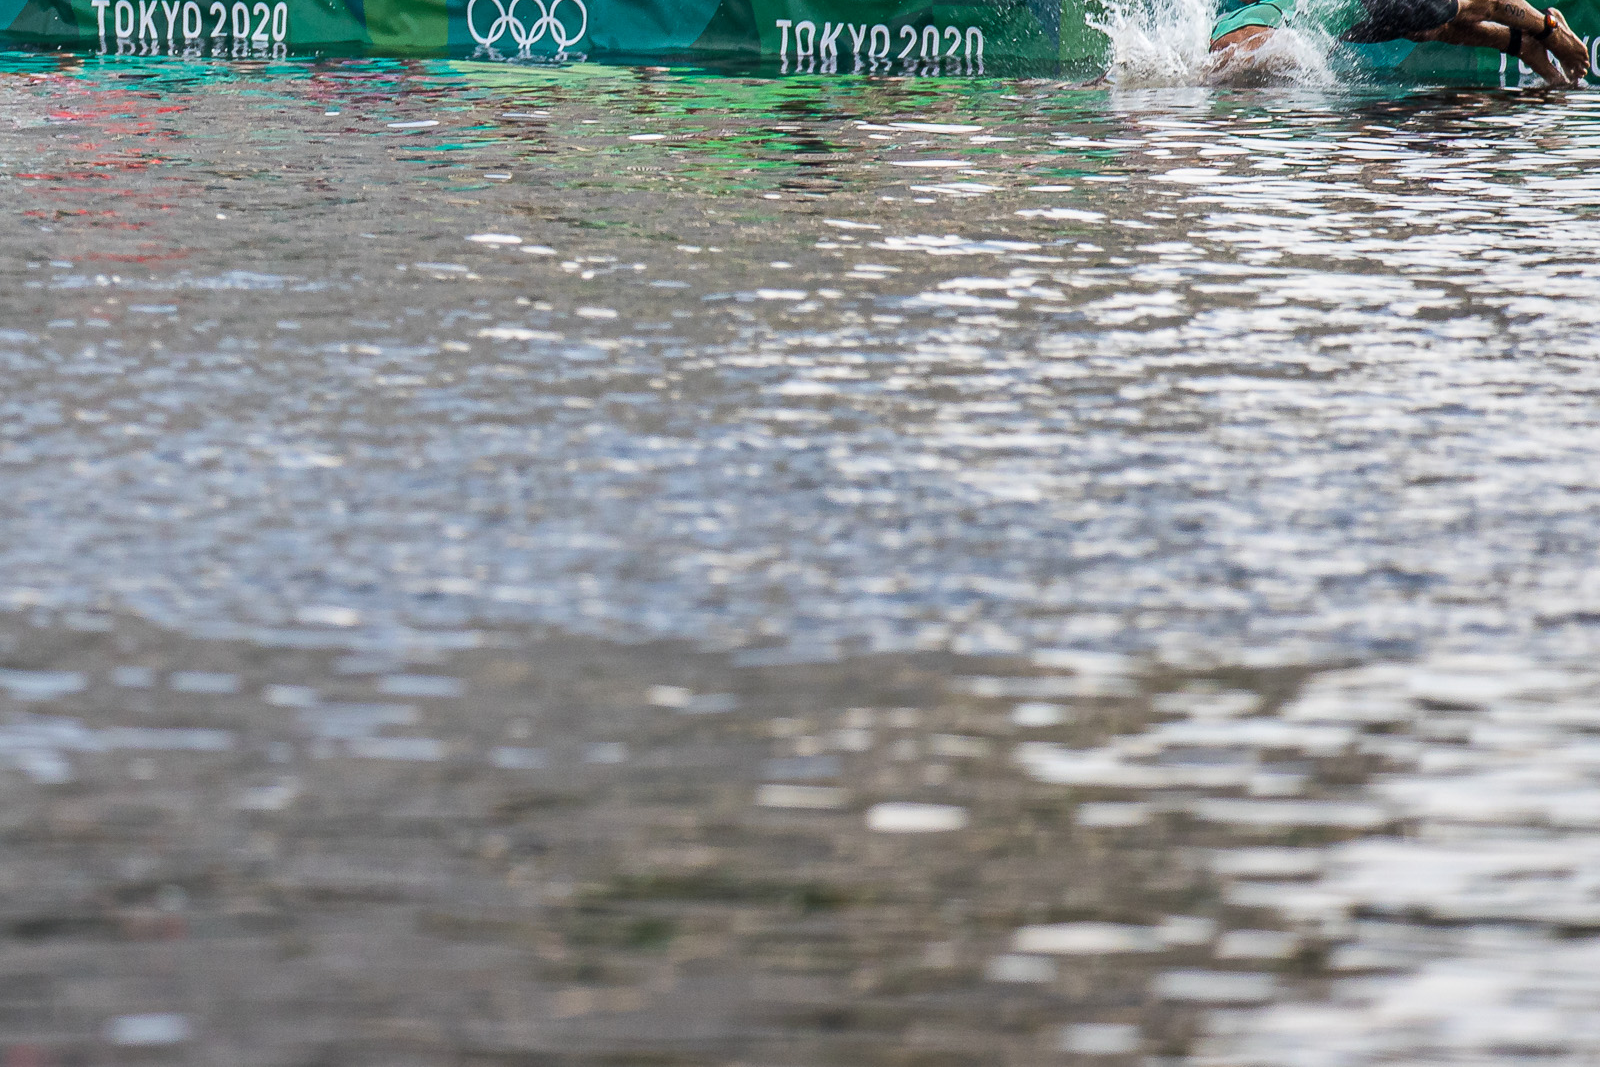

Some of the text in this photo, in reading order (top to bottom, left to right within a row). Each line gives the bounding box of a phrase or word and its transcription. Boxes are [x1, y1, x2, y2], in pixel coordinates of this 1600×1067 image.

[91, 0, 287, 41] TOKYO 2020
[776, 19, 984, 58] TOKYO 2020
